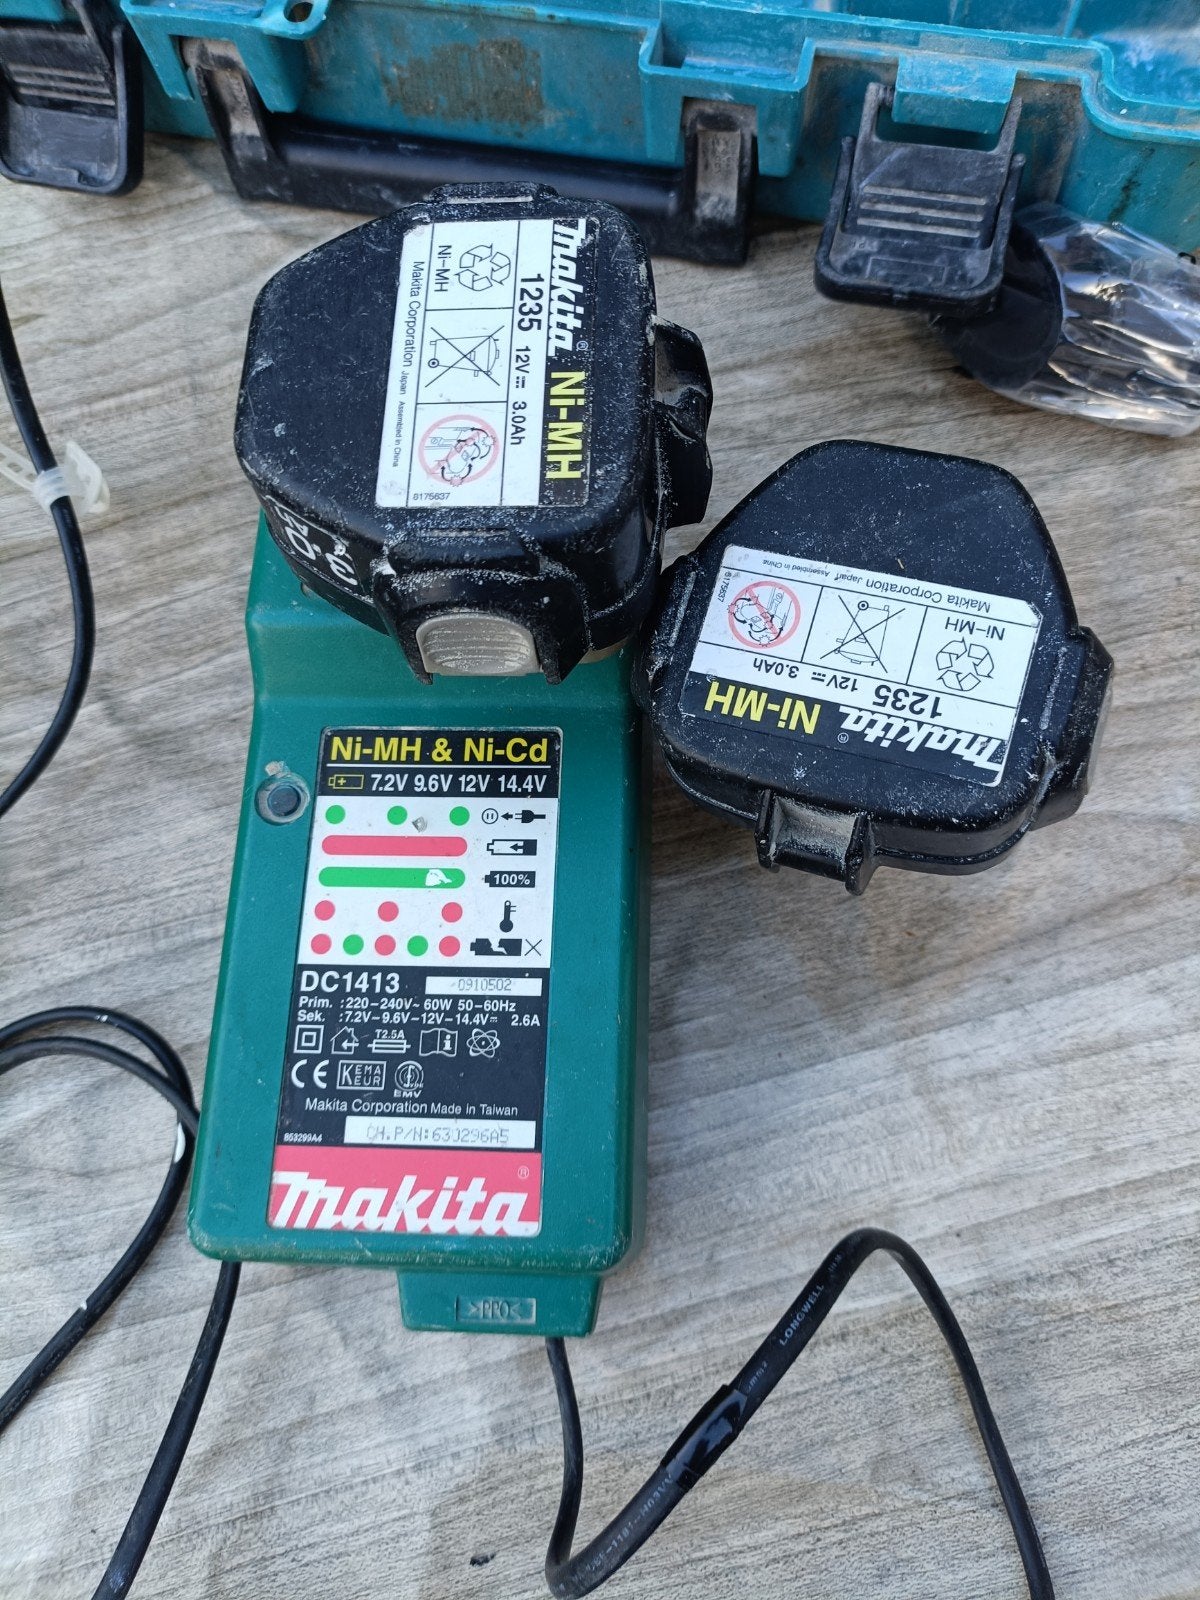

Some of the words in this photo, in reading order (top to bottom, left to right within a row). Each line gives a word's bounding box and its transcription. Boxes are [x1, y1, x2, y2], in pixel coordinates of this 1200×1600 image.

[408, 261, 425, 298] Makita
[434, 244, 452, 292] Ni-MH
[517, 273, 544, 332] 1235
[402, 299, 421, 367] Corporation
[398, 371, 409, 395] Japan
[394, 401, 405, 439] Assembled
[510, 401, 527, 446] 3.0Ah
[545, 371, 586, 479] Ni-MH
[392, 447, 401, 467] China
[763, 558, 783, 569] China
[793, 564, 830, 577] Assembled
[835, 570, 863, 584] Japan
[865, 578, 943, 605] Corporation
[946, 592, 991, 614] Makita
[944, 616, 1006, 641] Ni-MH
[752, 657, 800, 679] 3.0Ah
[704, 681, 821, 735] Ni-MH
[872, 684, 943, 719] 1235
[330, 736, 422, 762] Ni-MH
[431, 737, 452, 763] &
[463, 737, 548, 763] Ni-Cd
[370, 774, 409, 791] 7.2V
[413, 774, 453, 792] 9.6V
[458, 775, 490, 792] 12V
[498, 775, 547, 793] 14.4V
[493, 873, 531, 886] 100%
[300, 970, 400, 994] DC1413
[299, 996, 333, 1009] Prim.
[424, 999, 453, 1011] 60W
[297, 1010, 326, 1023] Sek.
[511, 1014, 540, 1027] 2.6A
[375, 1029, 405, 1040] T2.5A
[291, 1059, 330, 1089] CE
[305, 1097, 348, 1112] Makita
[352, 1098, 428, 1116] Corporation
[430, 1102, 462, 1115] Made
[466, 1103, 476, 1115] in
[480, 1103, 519, 1117] Taiwan
[779, 1284, 825, 1347] LONGWELL
